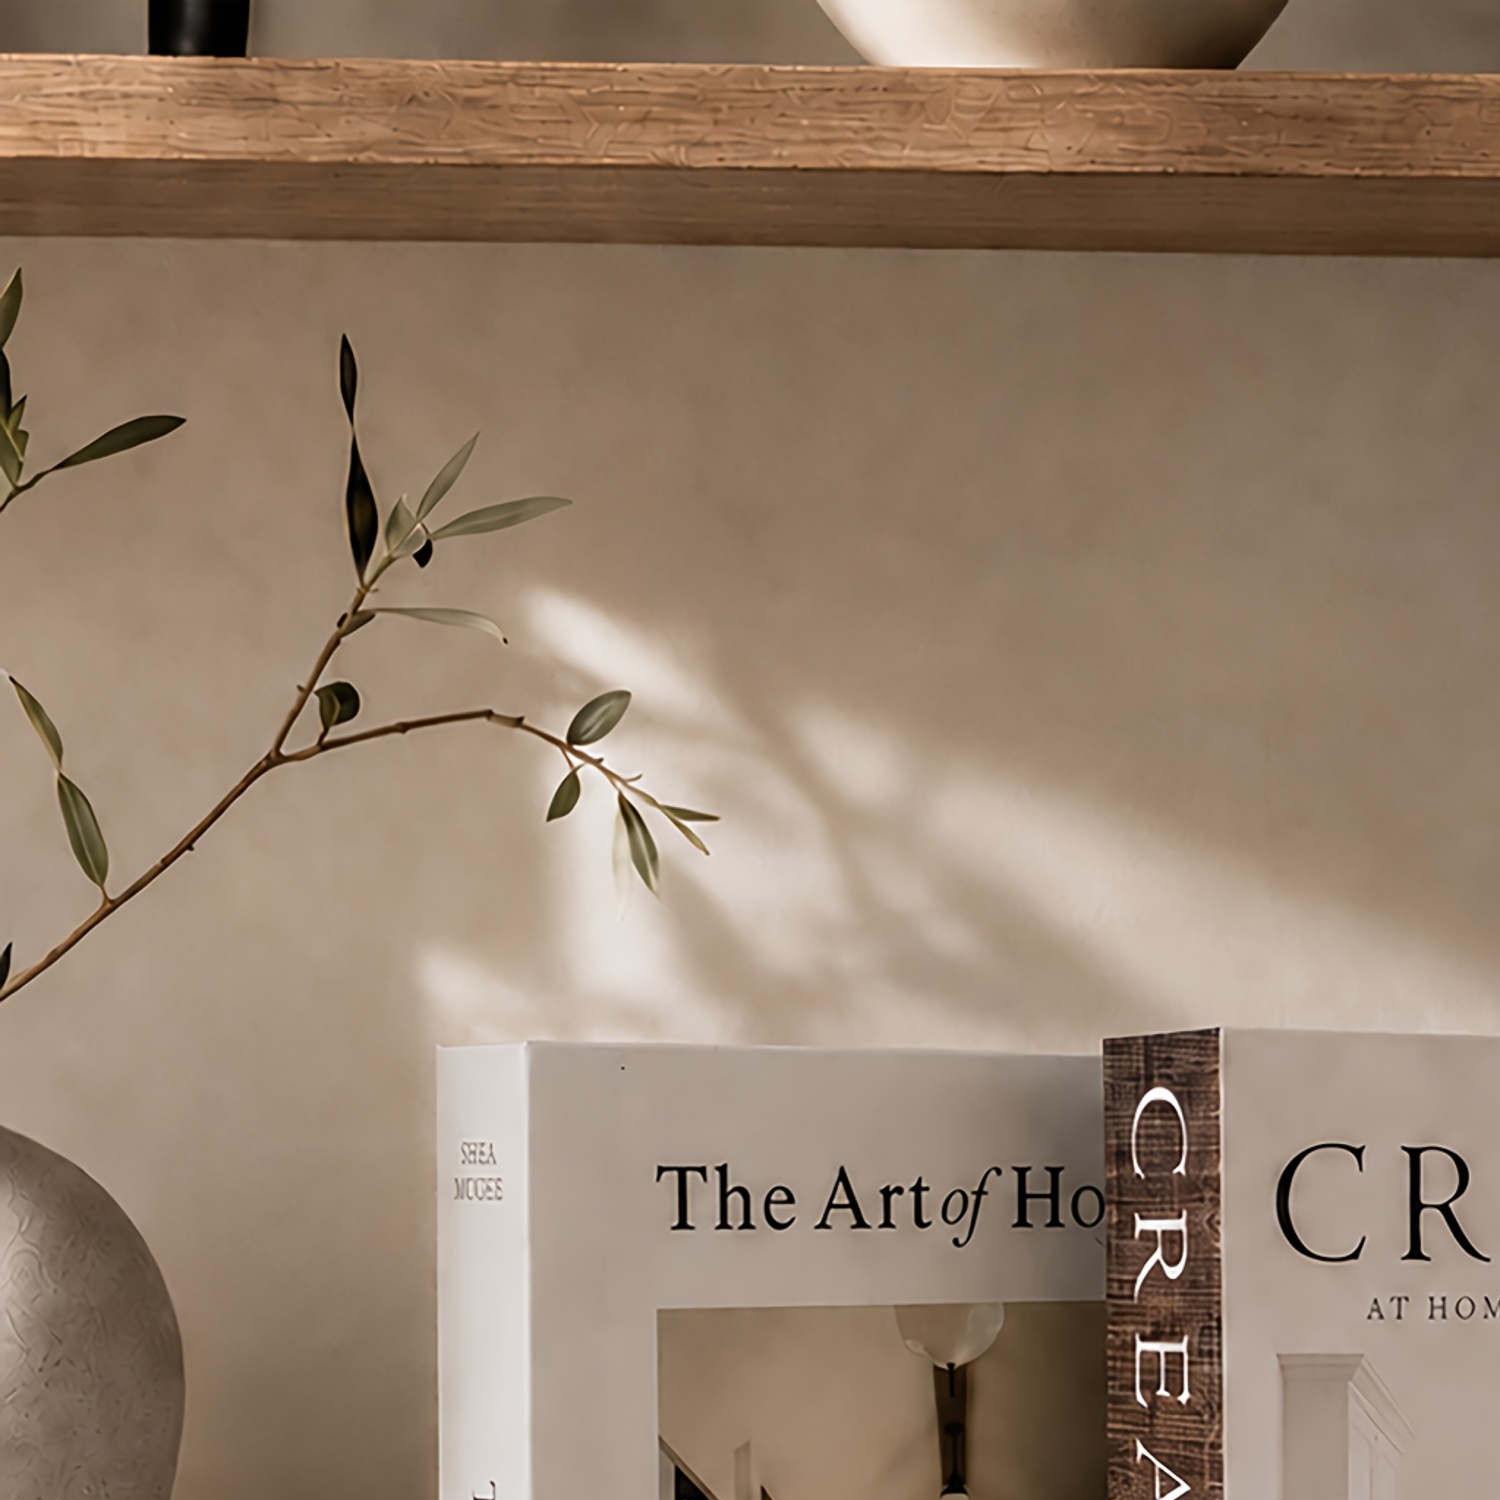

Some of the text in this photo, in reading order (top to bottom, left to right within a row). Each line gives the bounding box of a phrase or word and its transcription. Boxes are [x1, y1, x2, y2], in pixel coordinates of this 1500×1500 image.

[655, 1162, 1105, 1248] The Art of Ho
[1366, 1296, 1410, 1320] AT
